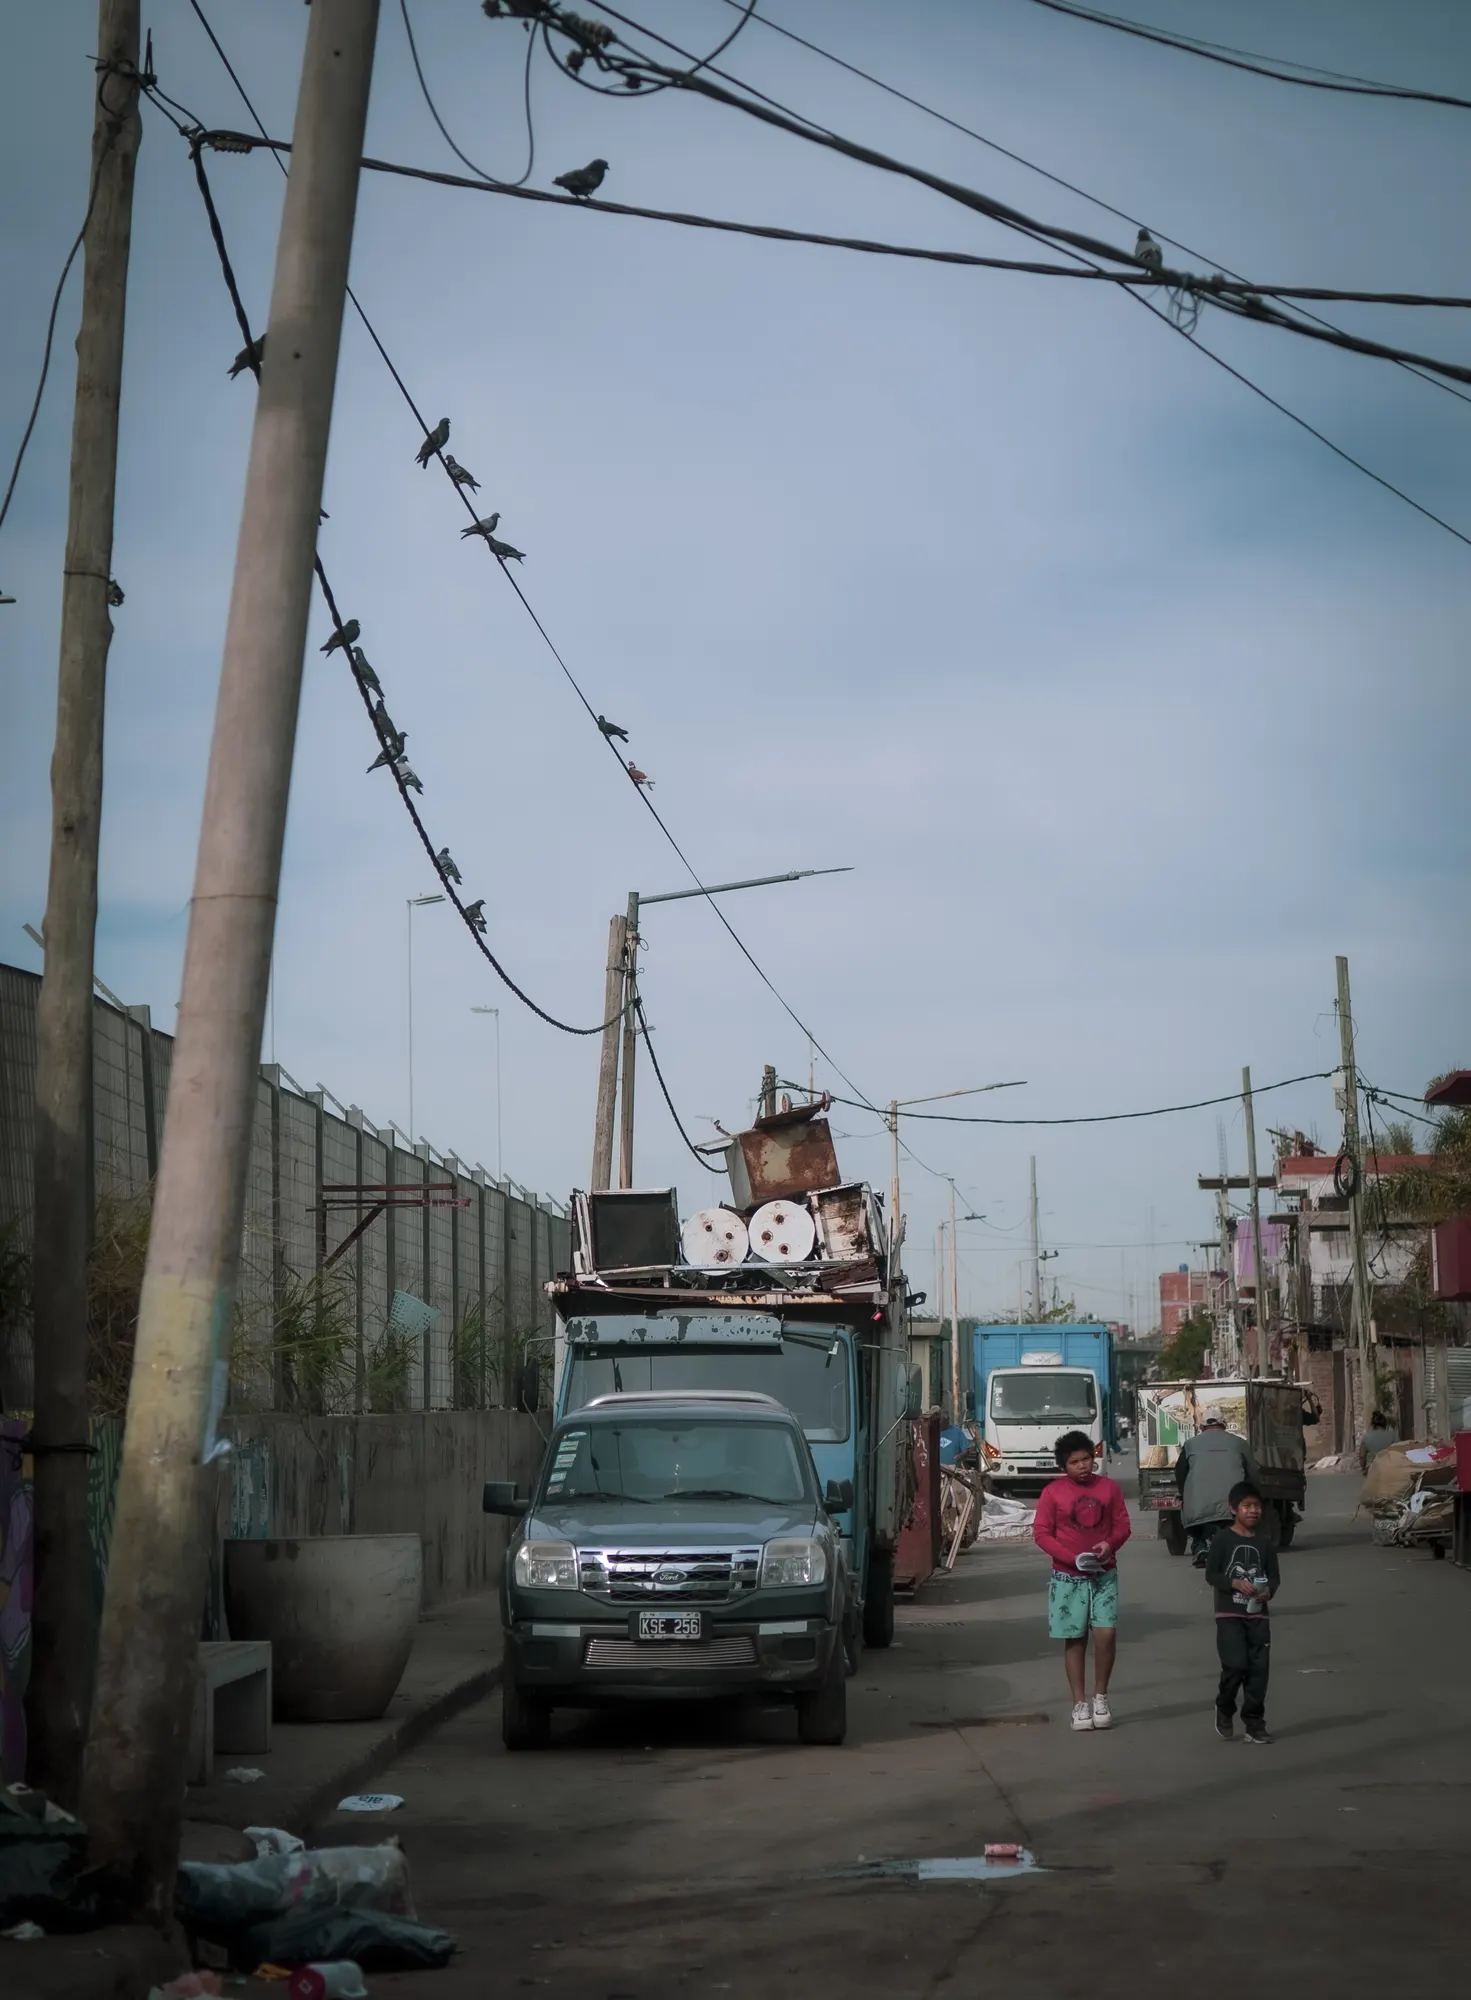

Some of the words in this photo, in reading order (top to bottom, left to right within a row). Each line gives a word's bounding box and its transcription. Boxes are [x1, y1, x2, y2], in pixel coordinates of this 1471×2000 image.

[659, 1572, 679, 1581] Ford
[642, 1618, 666, 1634] KSE
[674, 1618, 698, 1634] 256
